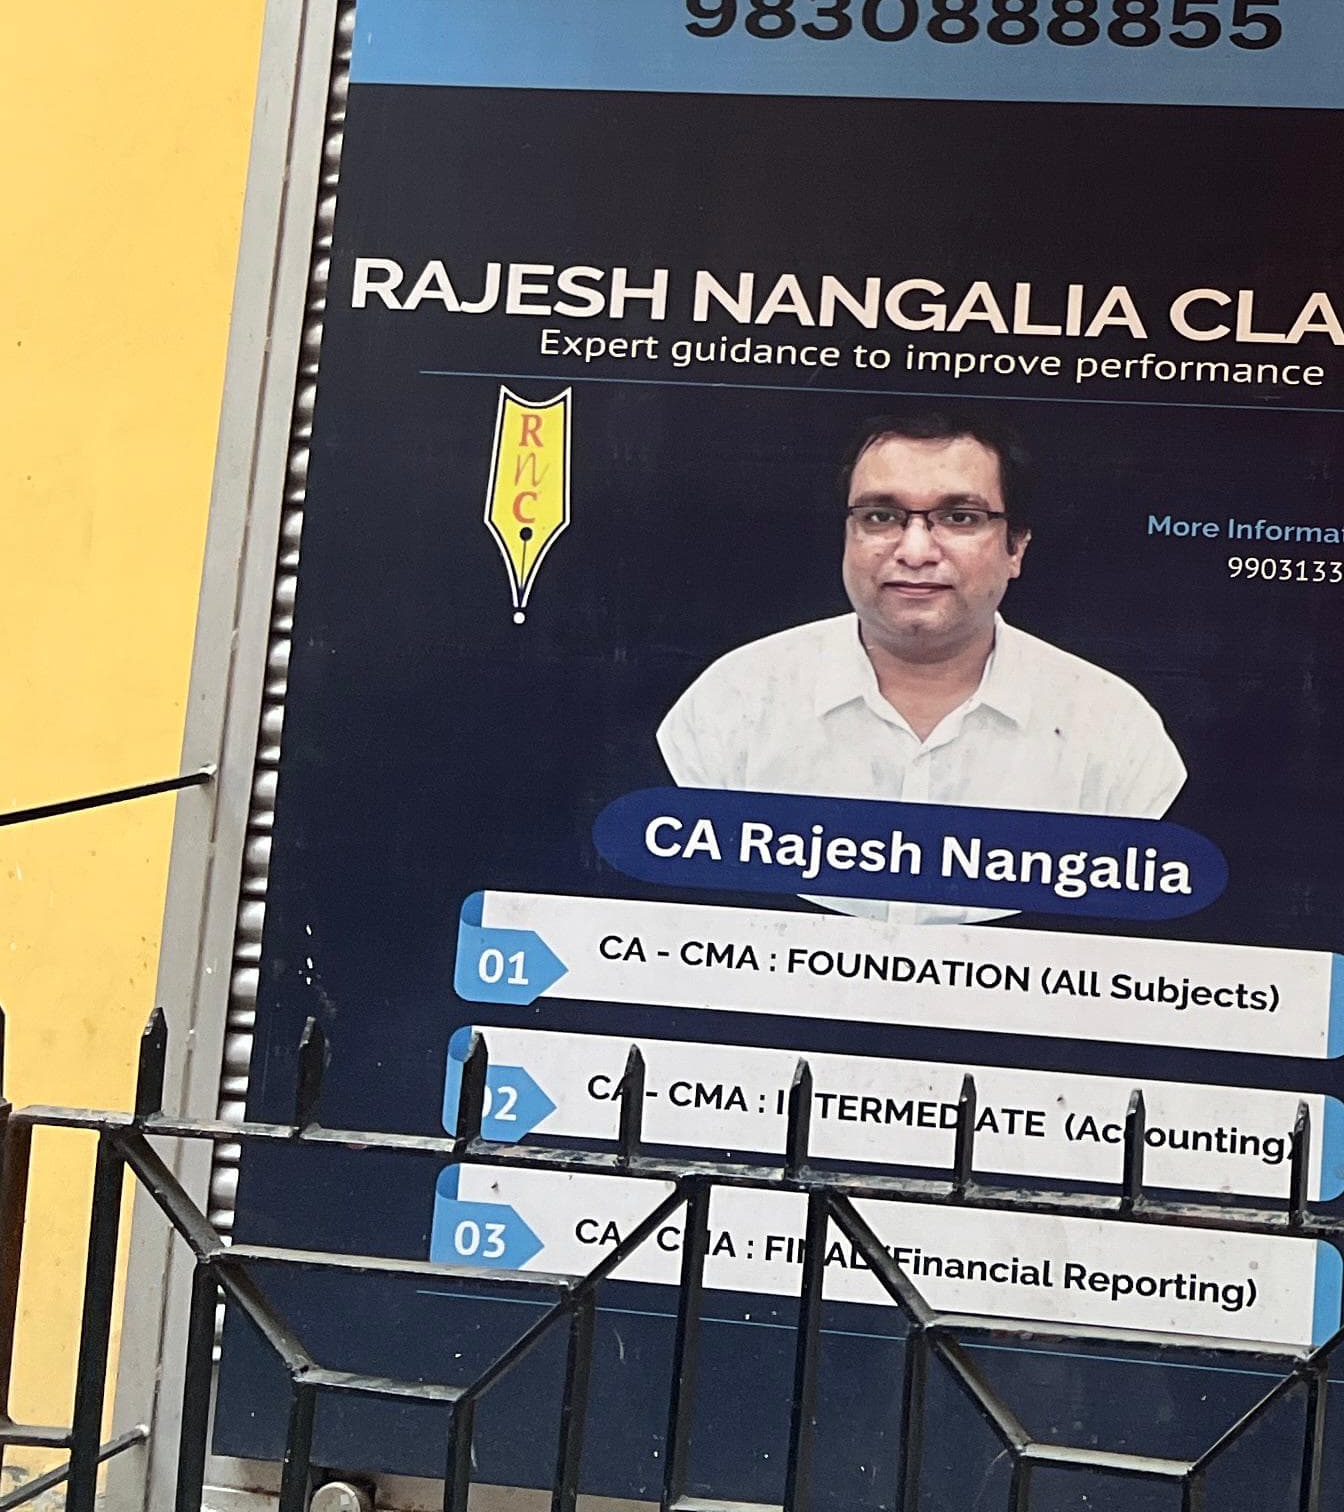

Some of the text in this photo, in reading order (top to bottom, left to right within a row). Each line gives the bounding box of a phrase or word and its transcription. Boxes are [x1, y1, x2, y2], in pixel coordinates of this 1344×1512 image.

[350, 257, 669, 321] RAJESH
[692, 272, 1148, 338] NANGALIA
[540, 329, 1325, 386] Expert guidance to improve performance
[1148, 514, 1220, 538] More
[644, 816, 1193, 897] CA Rajesh Nangalia
[478, 948, 529, 985] 01
[599, 935, 646, 962] CA
[680, 941, 759, 971] CMA
[787, 948, 1030, 992] FOUNDATION
[1040, 967, 1101, 998] (All
[1110, 974, 1280, 1013] Subjects)
[669, 1081, 749, 1112] CMA
[776, 1089, 1045, 1138] ITERMEDATE
[1065, 1112, 1298, 1165] (Acounting)
[454, 1221, 507, 1258] 03
[1063, 1264, 1258, 1312] Reporting)
